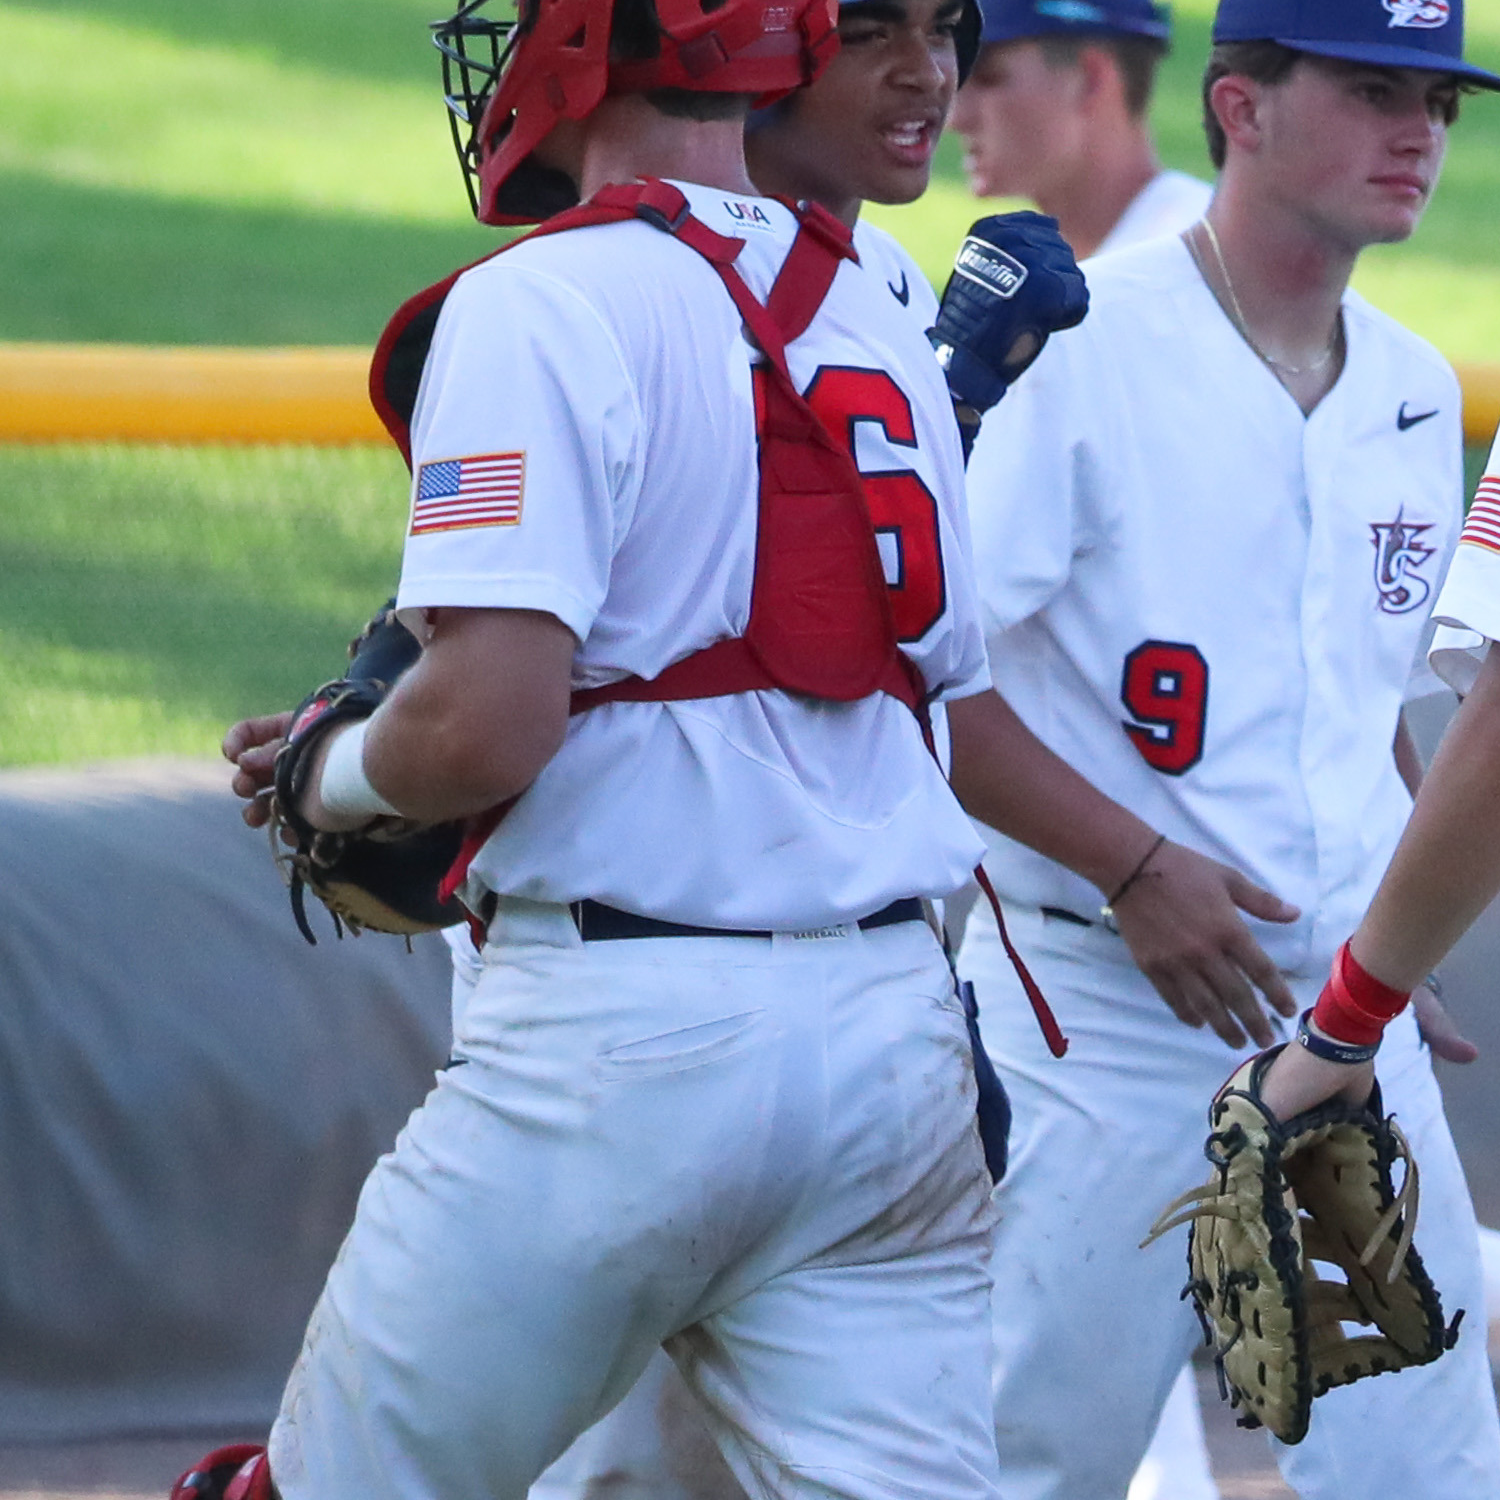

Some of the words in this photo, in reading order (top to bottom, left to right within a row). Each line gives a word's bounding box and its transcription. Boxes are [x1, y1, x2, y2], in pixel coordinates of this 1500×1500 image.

[723, 201, 771, 225] USA
[959, 243, 1018, 287] Franklin
[1121, 639, 1208, 776] 9
